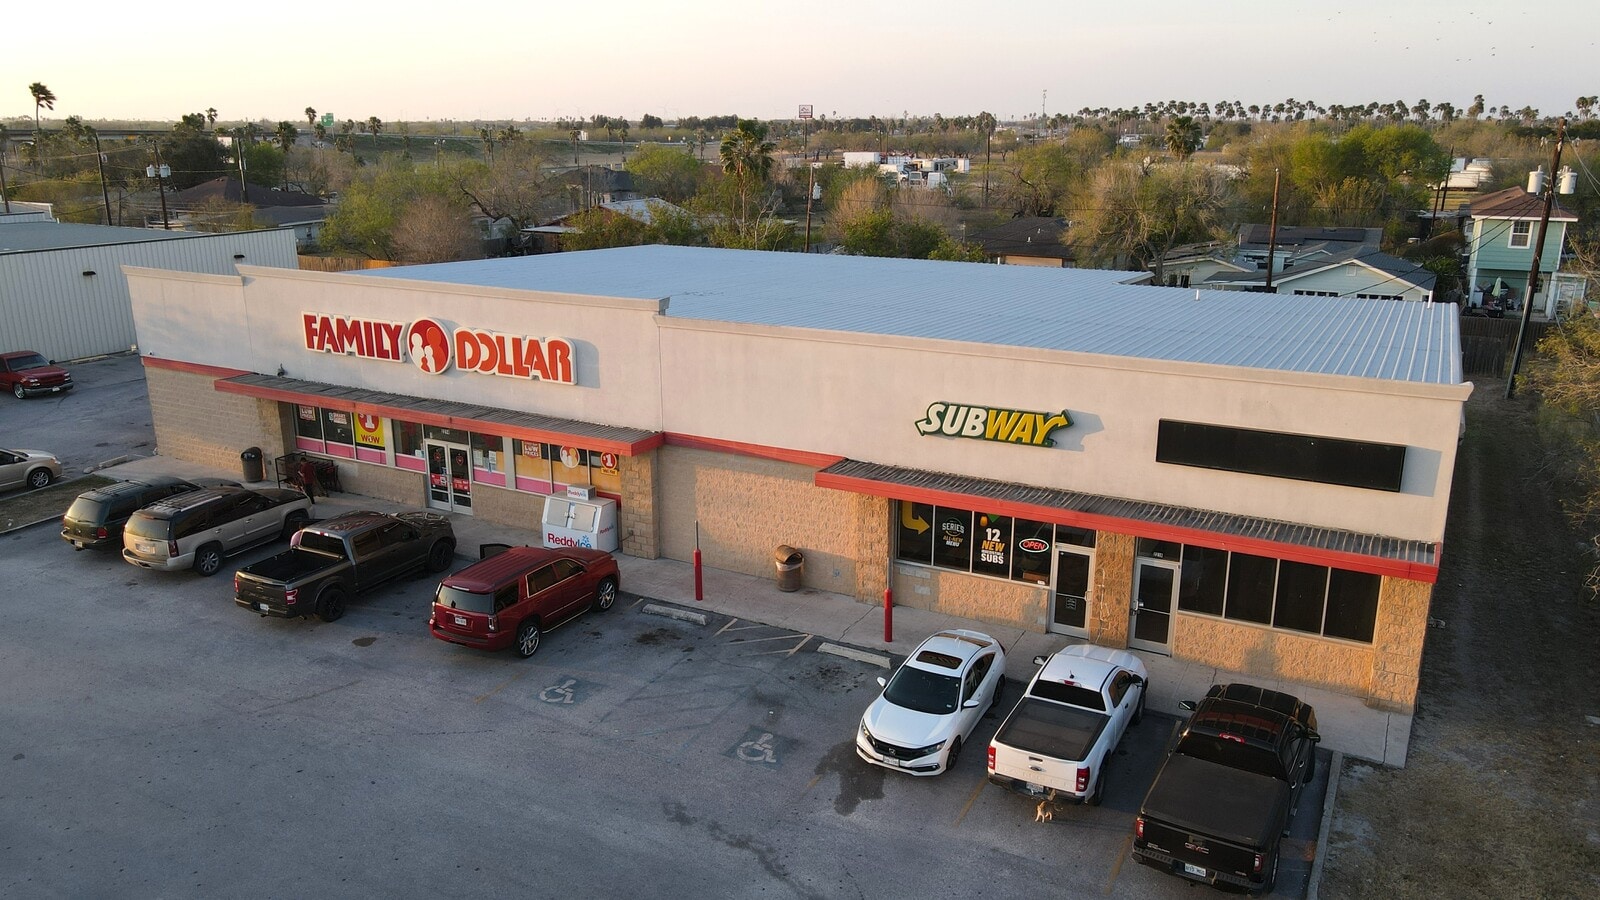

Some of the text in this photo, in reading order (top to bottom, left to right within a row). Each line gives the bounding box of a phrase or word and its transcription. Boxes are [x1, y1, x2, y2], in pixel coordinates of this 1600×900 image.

[303, 313, 573, 383] FAMILY DOLLAR
[917, 402, 1071, 446] SUBWAY
[524, 444, 539, 452] LOW
[942, 522, 965, 534] SERIES
[985, 528, 1001, 542] 12
[981, 540, 1006, 552] NEW
[1022, 540, 1046, 550] OPEN
[980, 553, 1004, 565] SUBS
